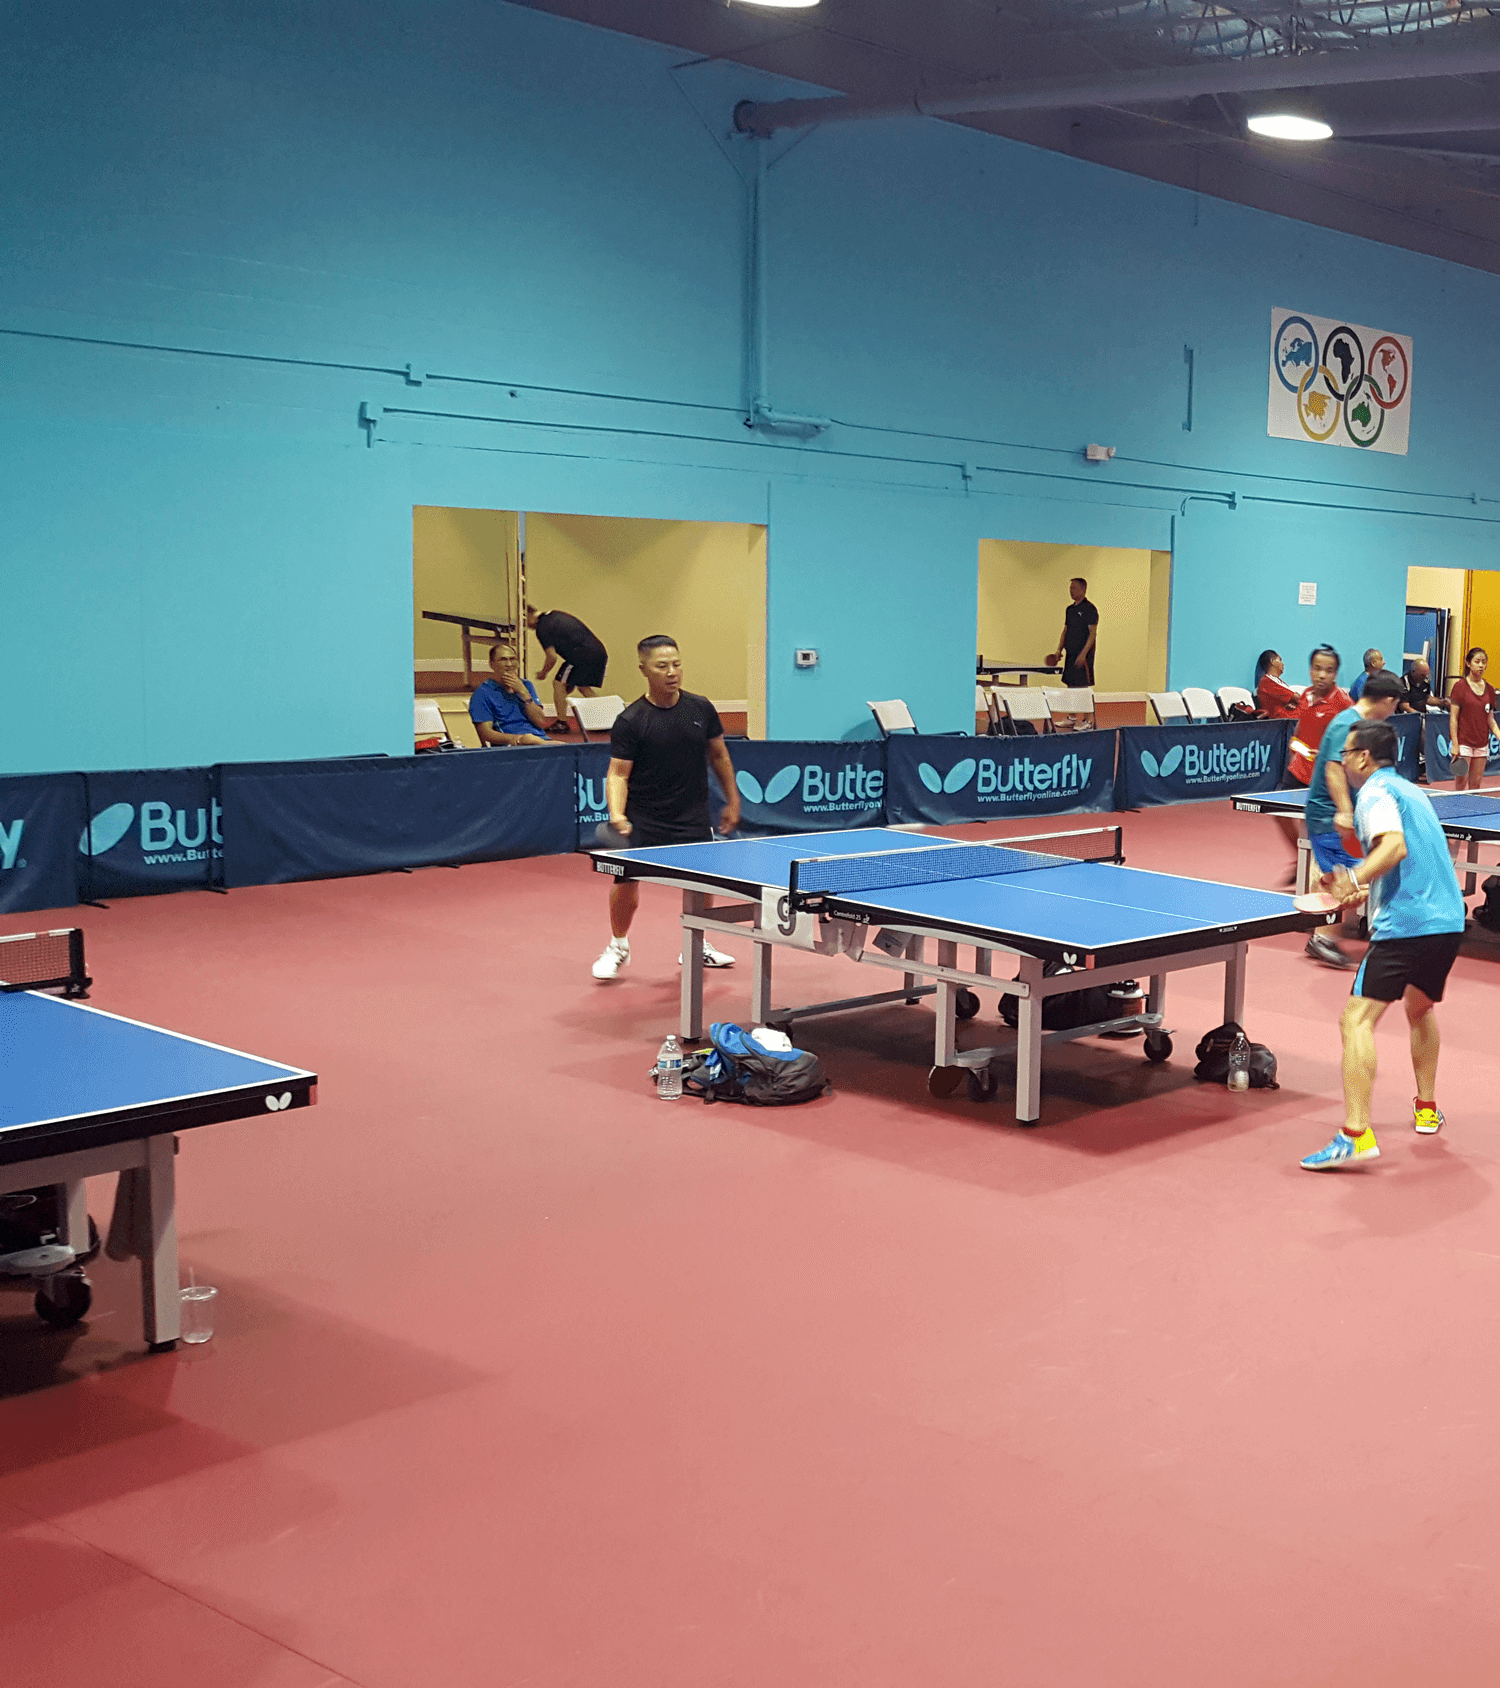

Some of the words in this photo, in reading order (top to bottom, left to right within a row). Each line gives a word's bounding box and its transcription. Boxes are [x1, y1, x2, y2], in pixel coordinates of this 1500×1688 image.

[977, 753, 1093, 793] Butterfly
[1184, 740, 1272, 776] Butterfly
[977, 788, 1079, 803] www.Butterflyonline.com
[596, 861, 625, 877] BUTTERFLY
[776, 894, 797, 937] 9
